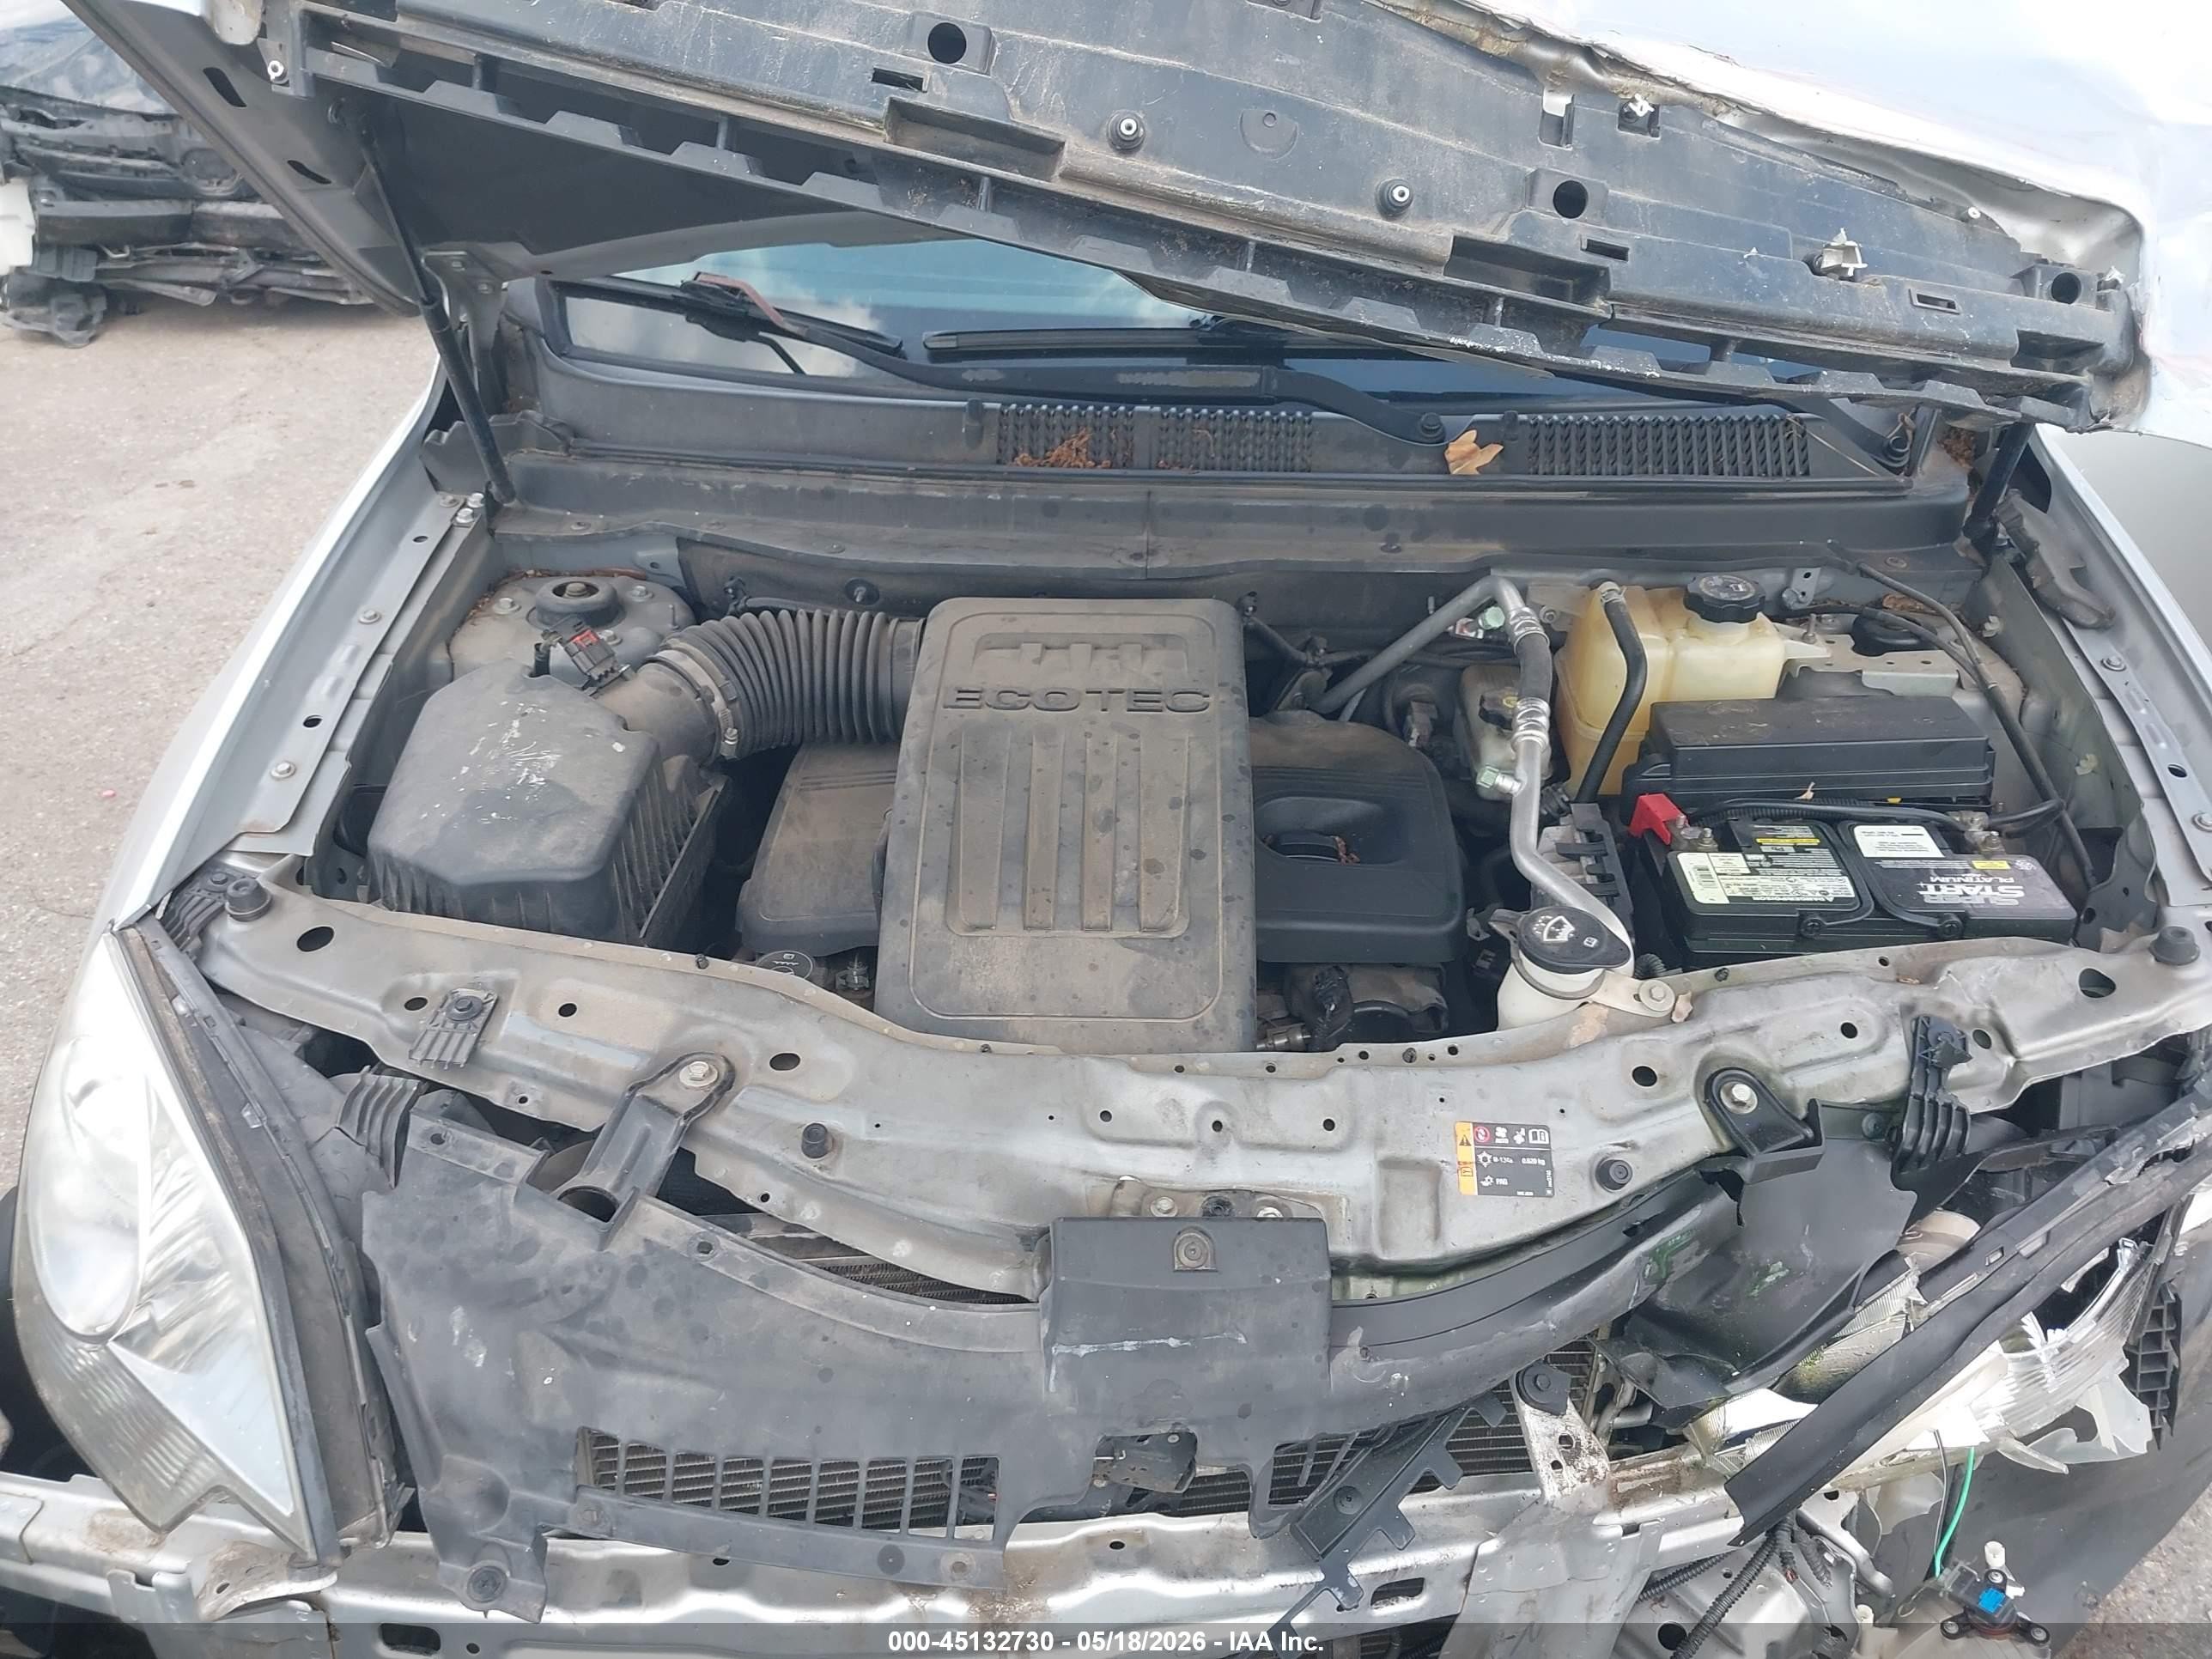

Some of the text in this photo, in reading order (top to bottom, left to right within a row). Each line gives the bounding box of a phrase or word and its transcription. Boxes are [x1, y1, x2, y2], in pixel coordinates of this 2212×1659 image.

[943, 687, 1210, 713] ECOTEC
[1929, 875, 2014, 884] PLATINUM
[1917, 884, 2025, 898] START
[1924, 895, 2019, 906] SUPER
